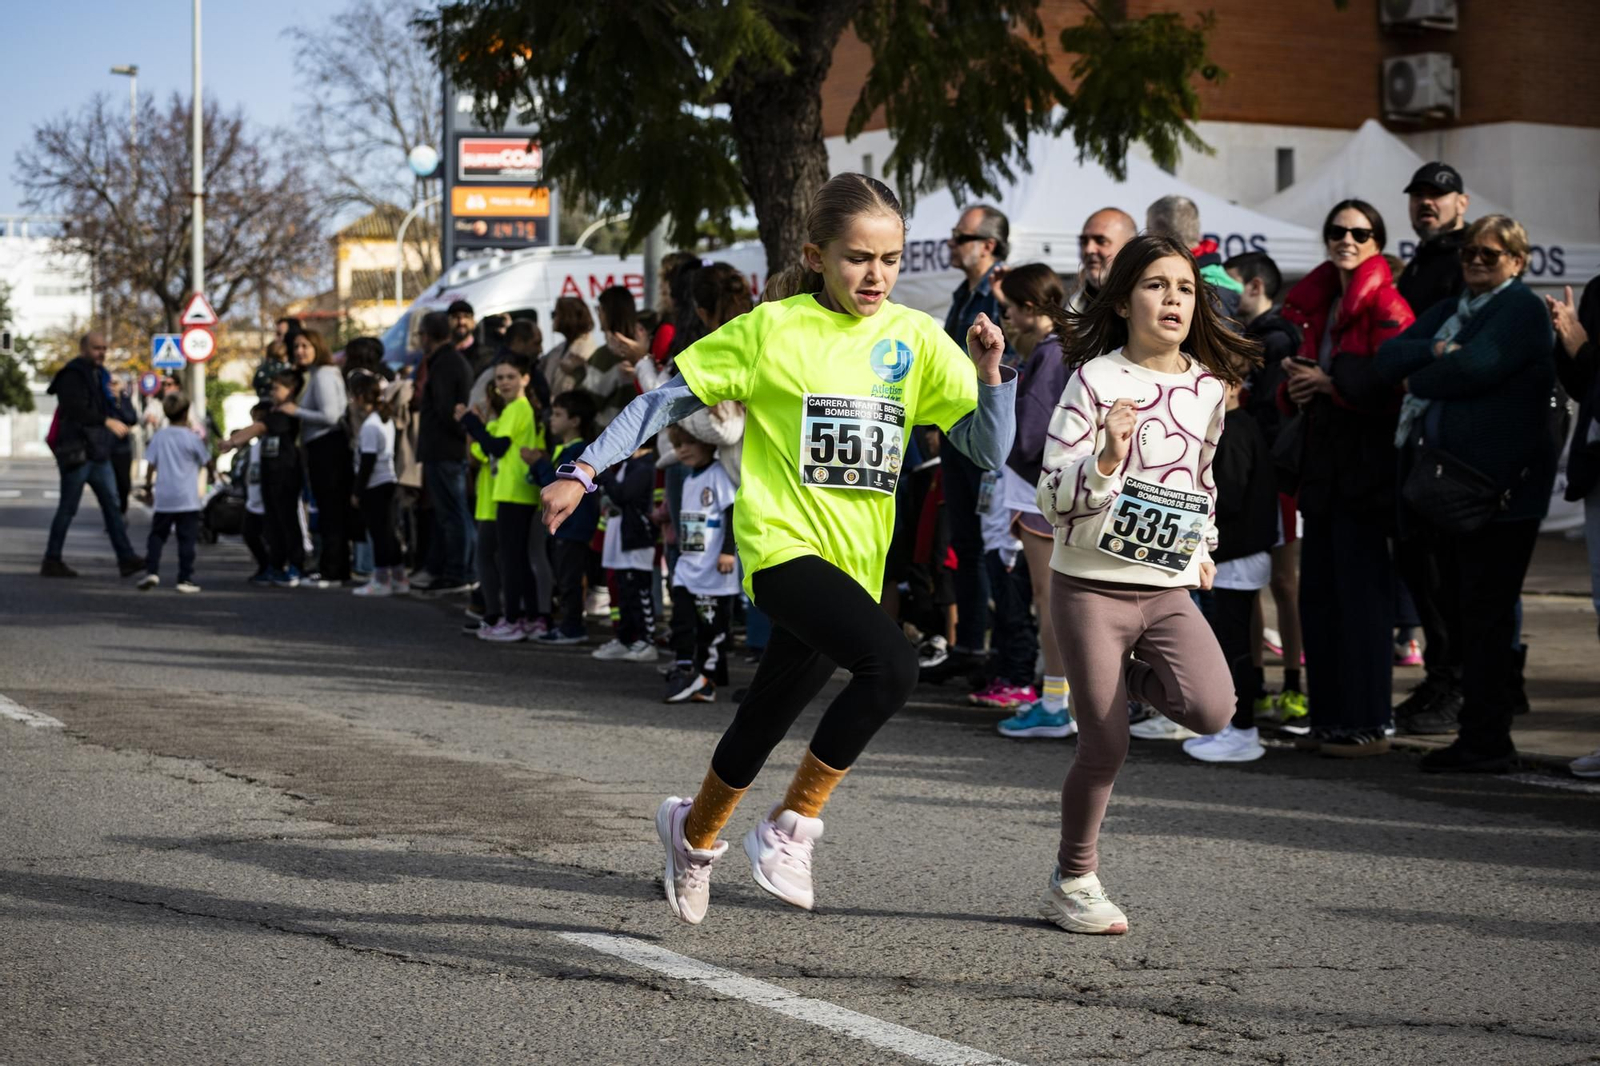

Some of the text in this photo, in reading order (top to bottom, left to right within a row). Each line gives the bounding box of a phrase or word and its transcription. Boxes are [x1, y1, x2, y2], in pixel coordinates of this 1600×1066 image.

[871, 384, 903, 395] Atletism
[808, 398, 848, 408] CARRERA
[849, 400, 883, 412] INFANTIL
[824, 408, 898, 424] BOMBEROS DE JEREZ
[810, 422, 884, 467] 553
[1126, 478, 1159, 495] CARRERA
[1159, 488, 1186, 501] INFANTIL
[1137, 490, 1202, 512] BOMBEROS DE JEREZ
[1113, 500, 1182, 549] 535
